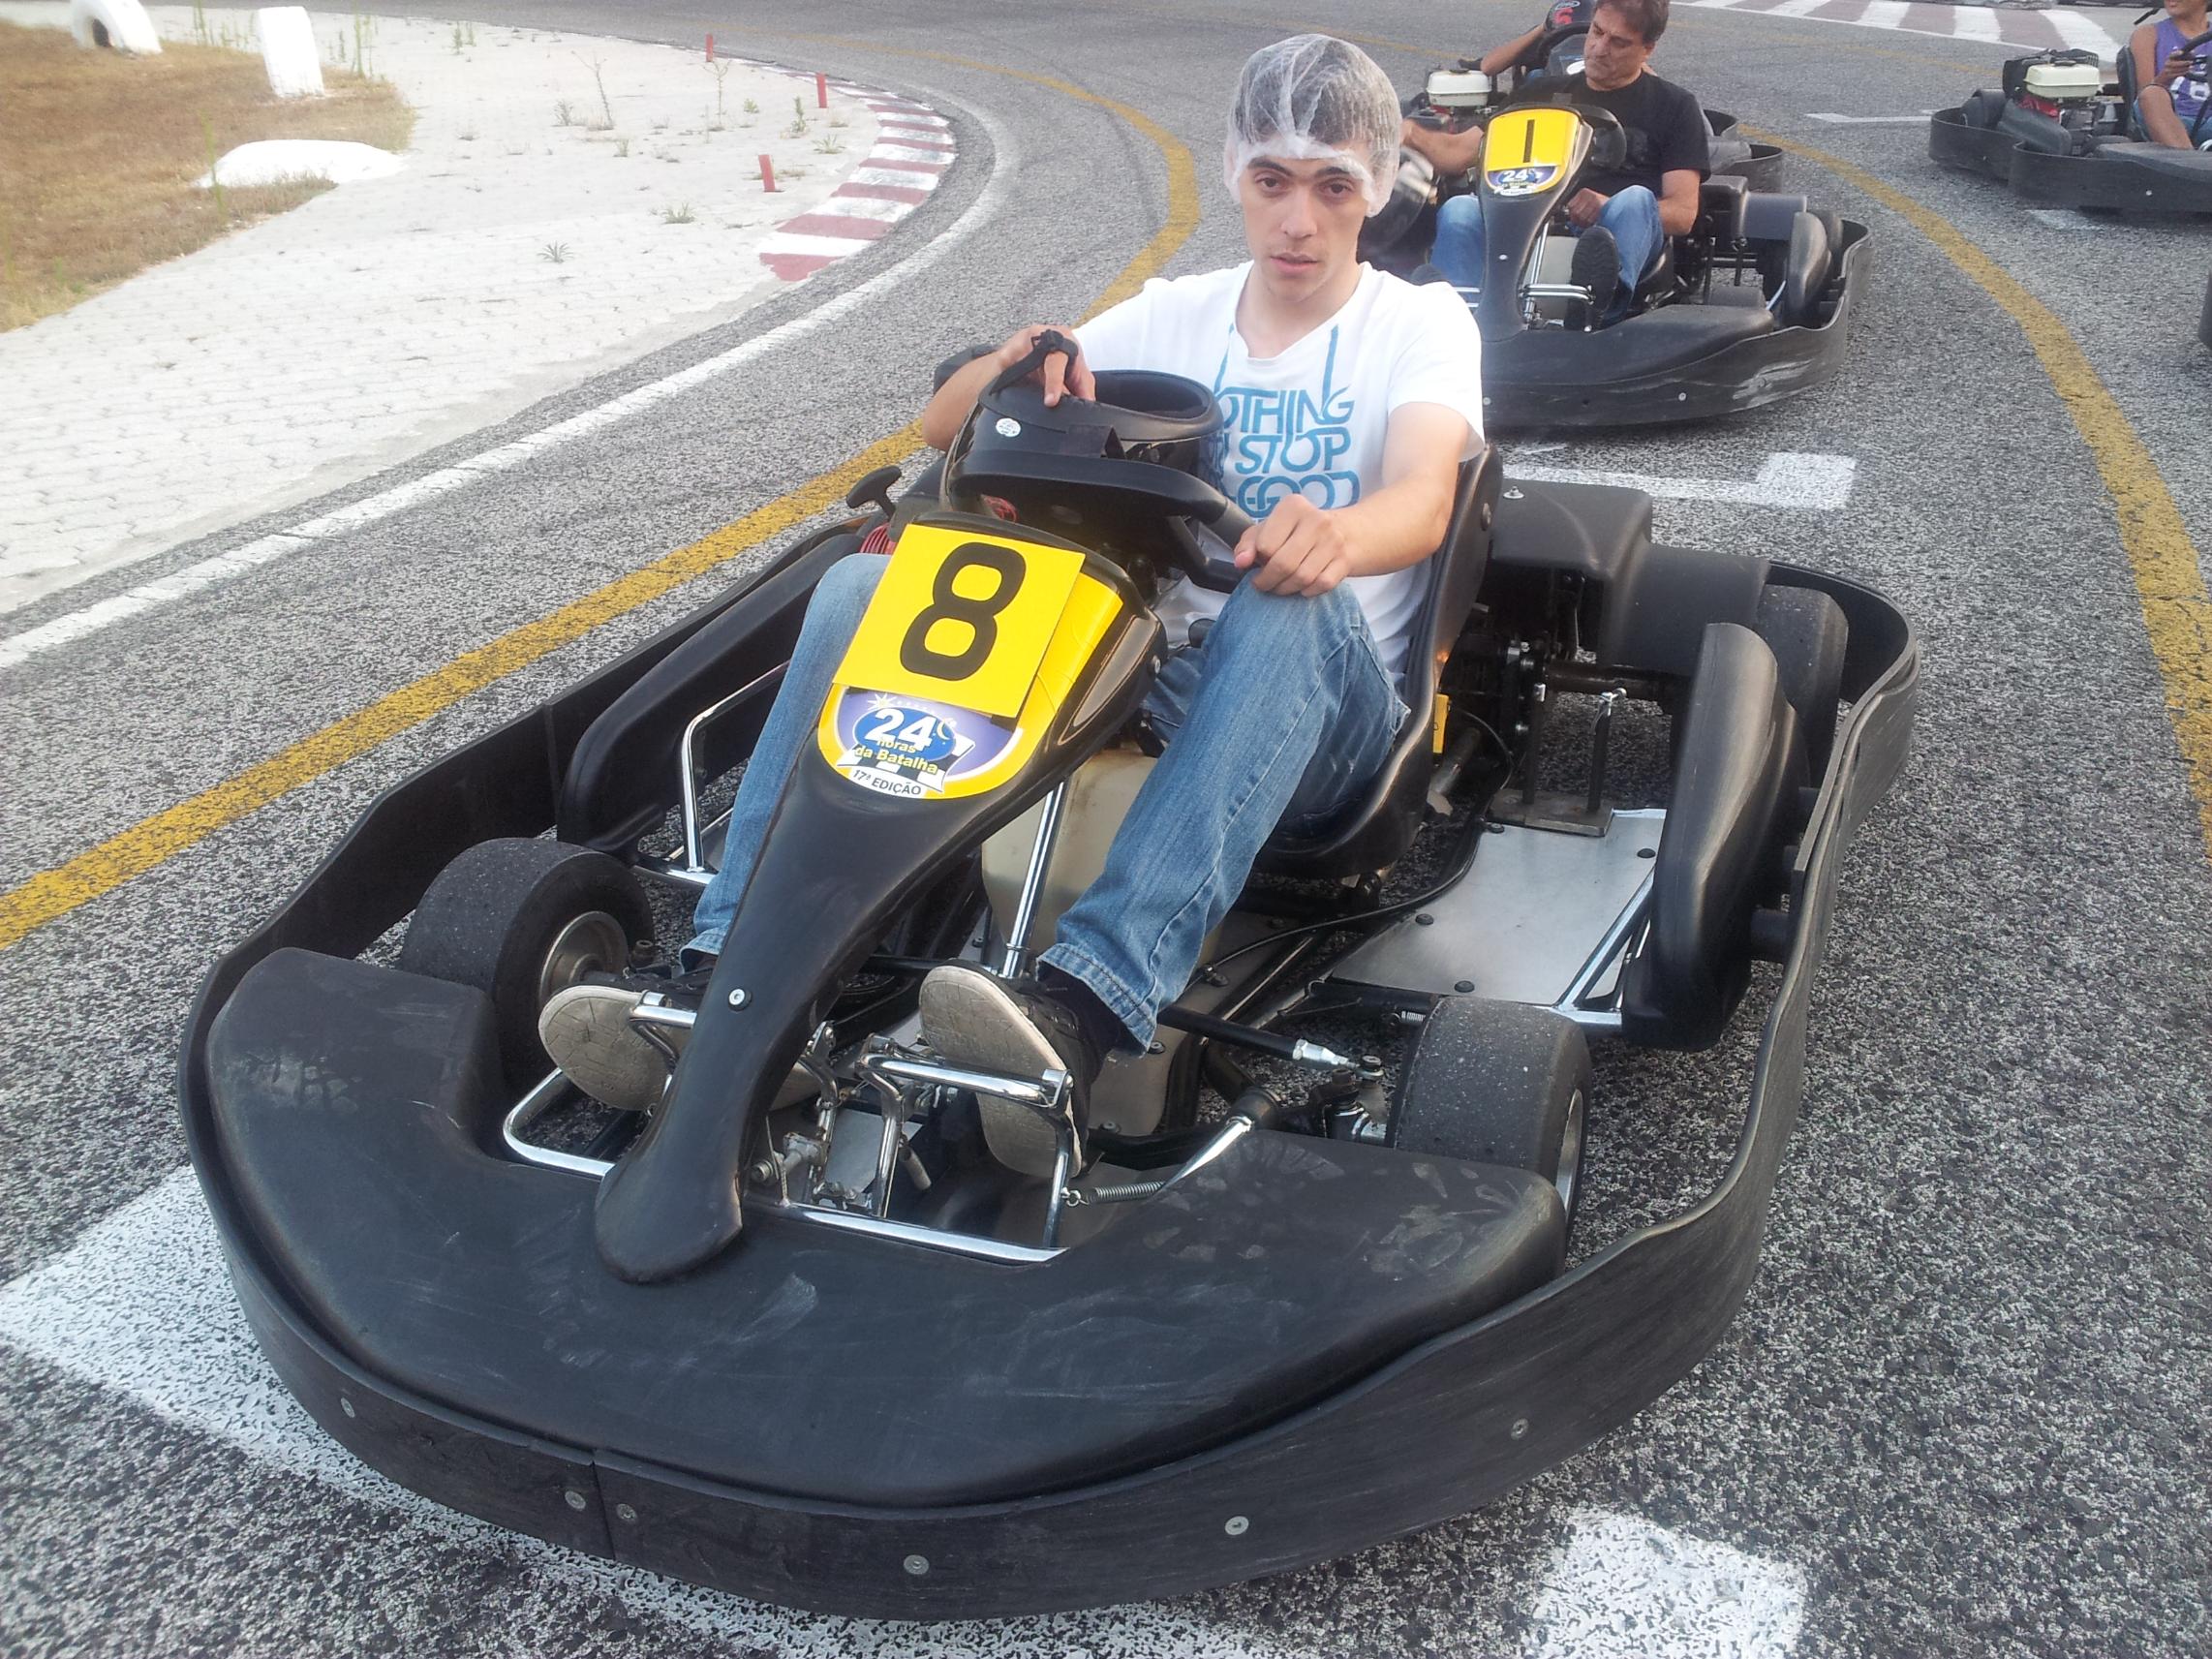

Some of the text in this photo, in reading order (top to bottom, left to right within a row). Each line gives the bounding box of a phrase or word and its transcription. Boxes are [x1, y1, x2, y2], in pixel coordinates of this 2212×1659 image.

[1502, 169, 1529, 182] 24
[1235, 426, 1351, 474] STOP
[900, 541, 1027, 682] 8
[865, 708, 937, 752] 24
[876, 735, 917, 754] horas
[855, 745, 938, 775] da Batalha
[872, 777, 922, 796] EDIÇÃO
